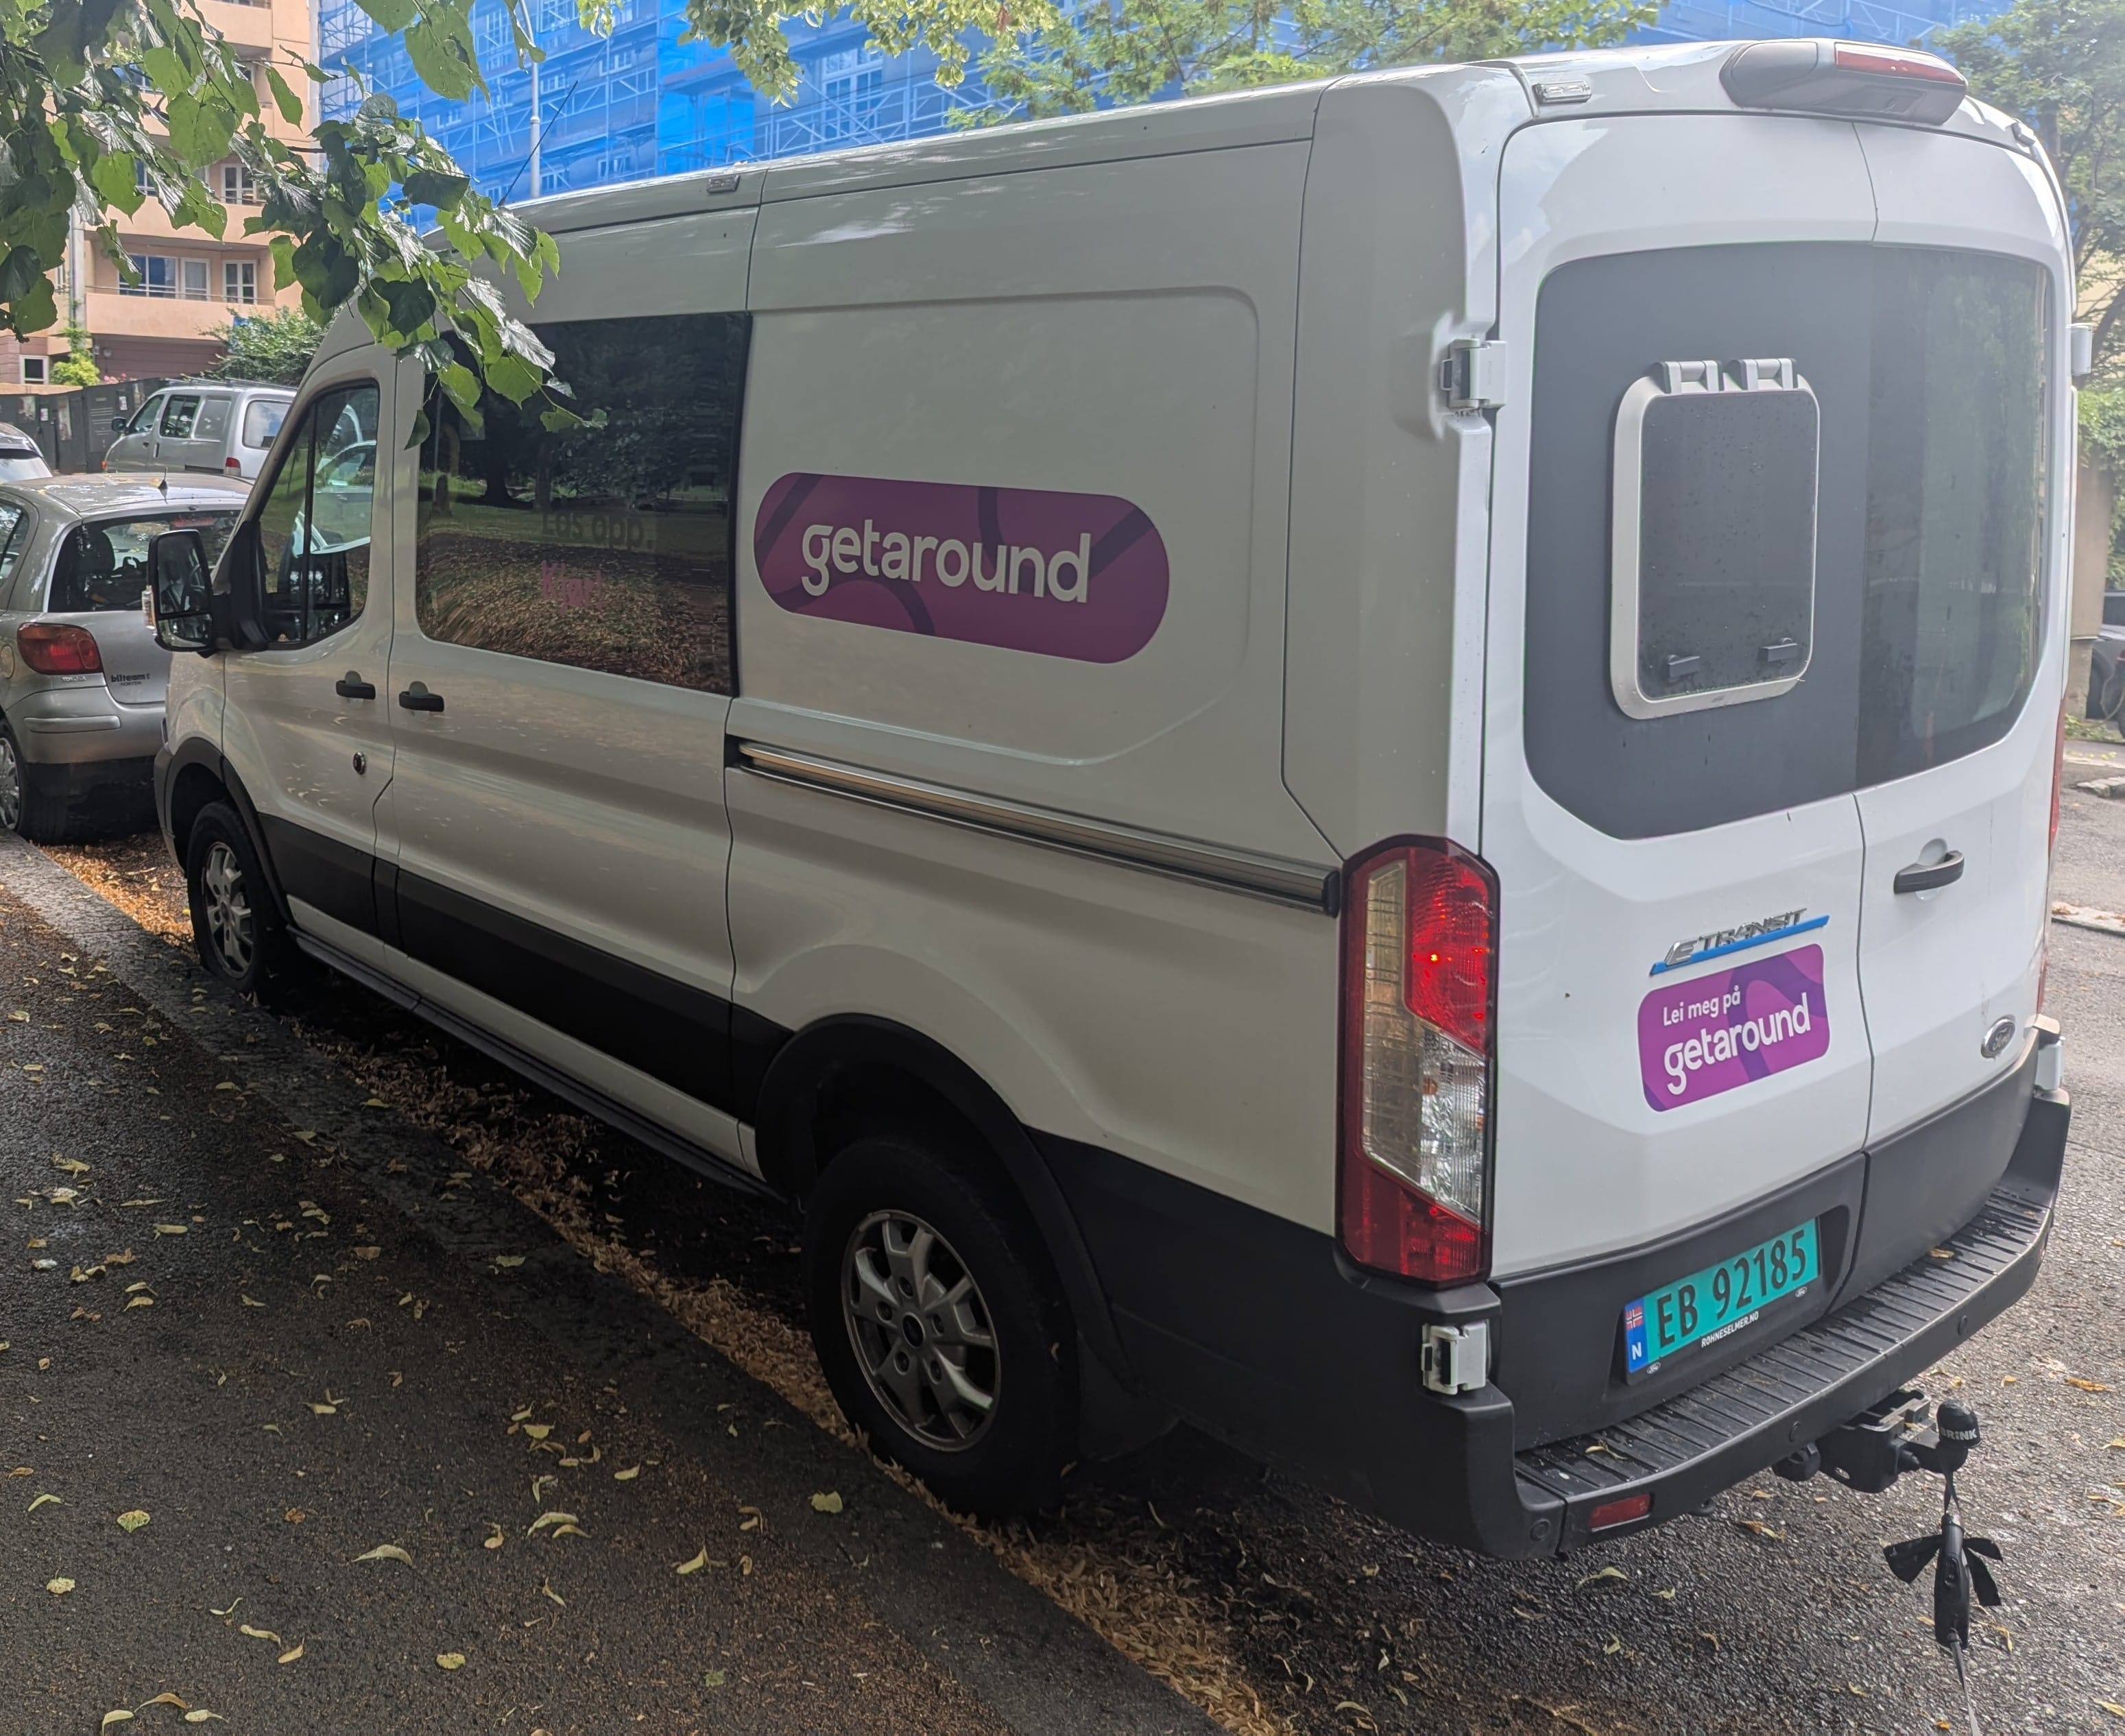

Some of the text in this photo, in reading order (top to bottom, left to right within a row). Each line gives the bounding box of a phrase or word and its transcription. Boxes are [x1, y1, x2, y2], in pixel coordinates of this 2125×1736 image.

[801, 519, 1091, 603] getaround
[1664, 985, 1741, 1026] Lei meg på
[1664, 992, 1811, 1095] getaround
[1656, 1229, 1806, 1348] EB 92185
[1631, 1342, 1642, 1360] N
